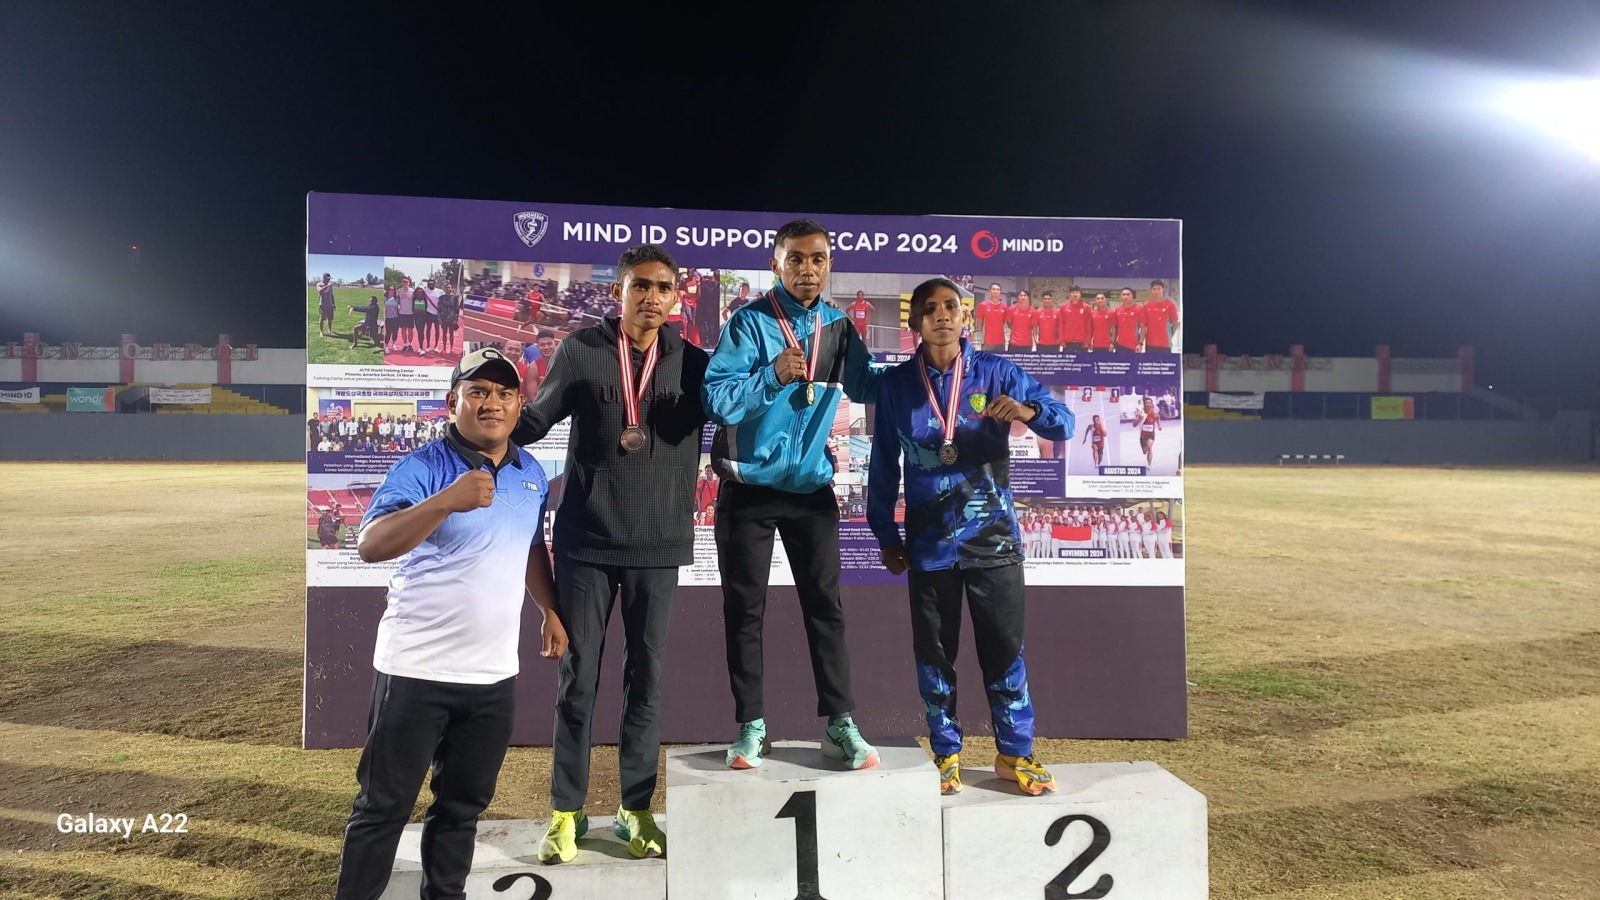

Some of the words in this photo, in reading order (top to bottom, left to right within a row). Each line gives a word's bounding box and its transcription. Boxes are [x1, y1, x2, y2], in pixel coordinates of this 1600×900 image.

[563, 221, 632, 243] MIND
[641, 225, 667, 245] ID
[675, 227, 777, 248] SUPPOR
[828, 232, 889, 252] ECAP
[896, 233, 958, 253] 2024
[1002, 238, 1044, 252] MIND
[1047, 239, 1064, 252] ID
[1104, 467, 1127, 475] AGUSTUS
[1127, 467, 1141, 475] 2024
[1061, 549, 1089, 557] NOVEMBER
[1089, 549, 1104, 557] 2024
[774, 790, 829, 900] 1
[1043, 814, 1113, 900] 2
